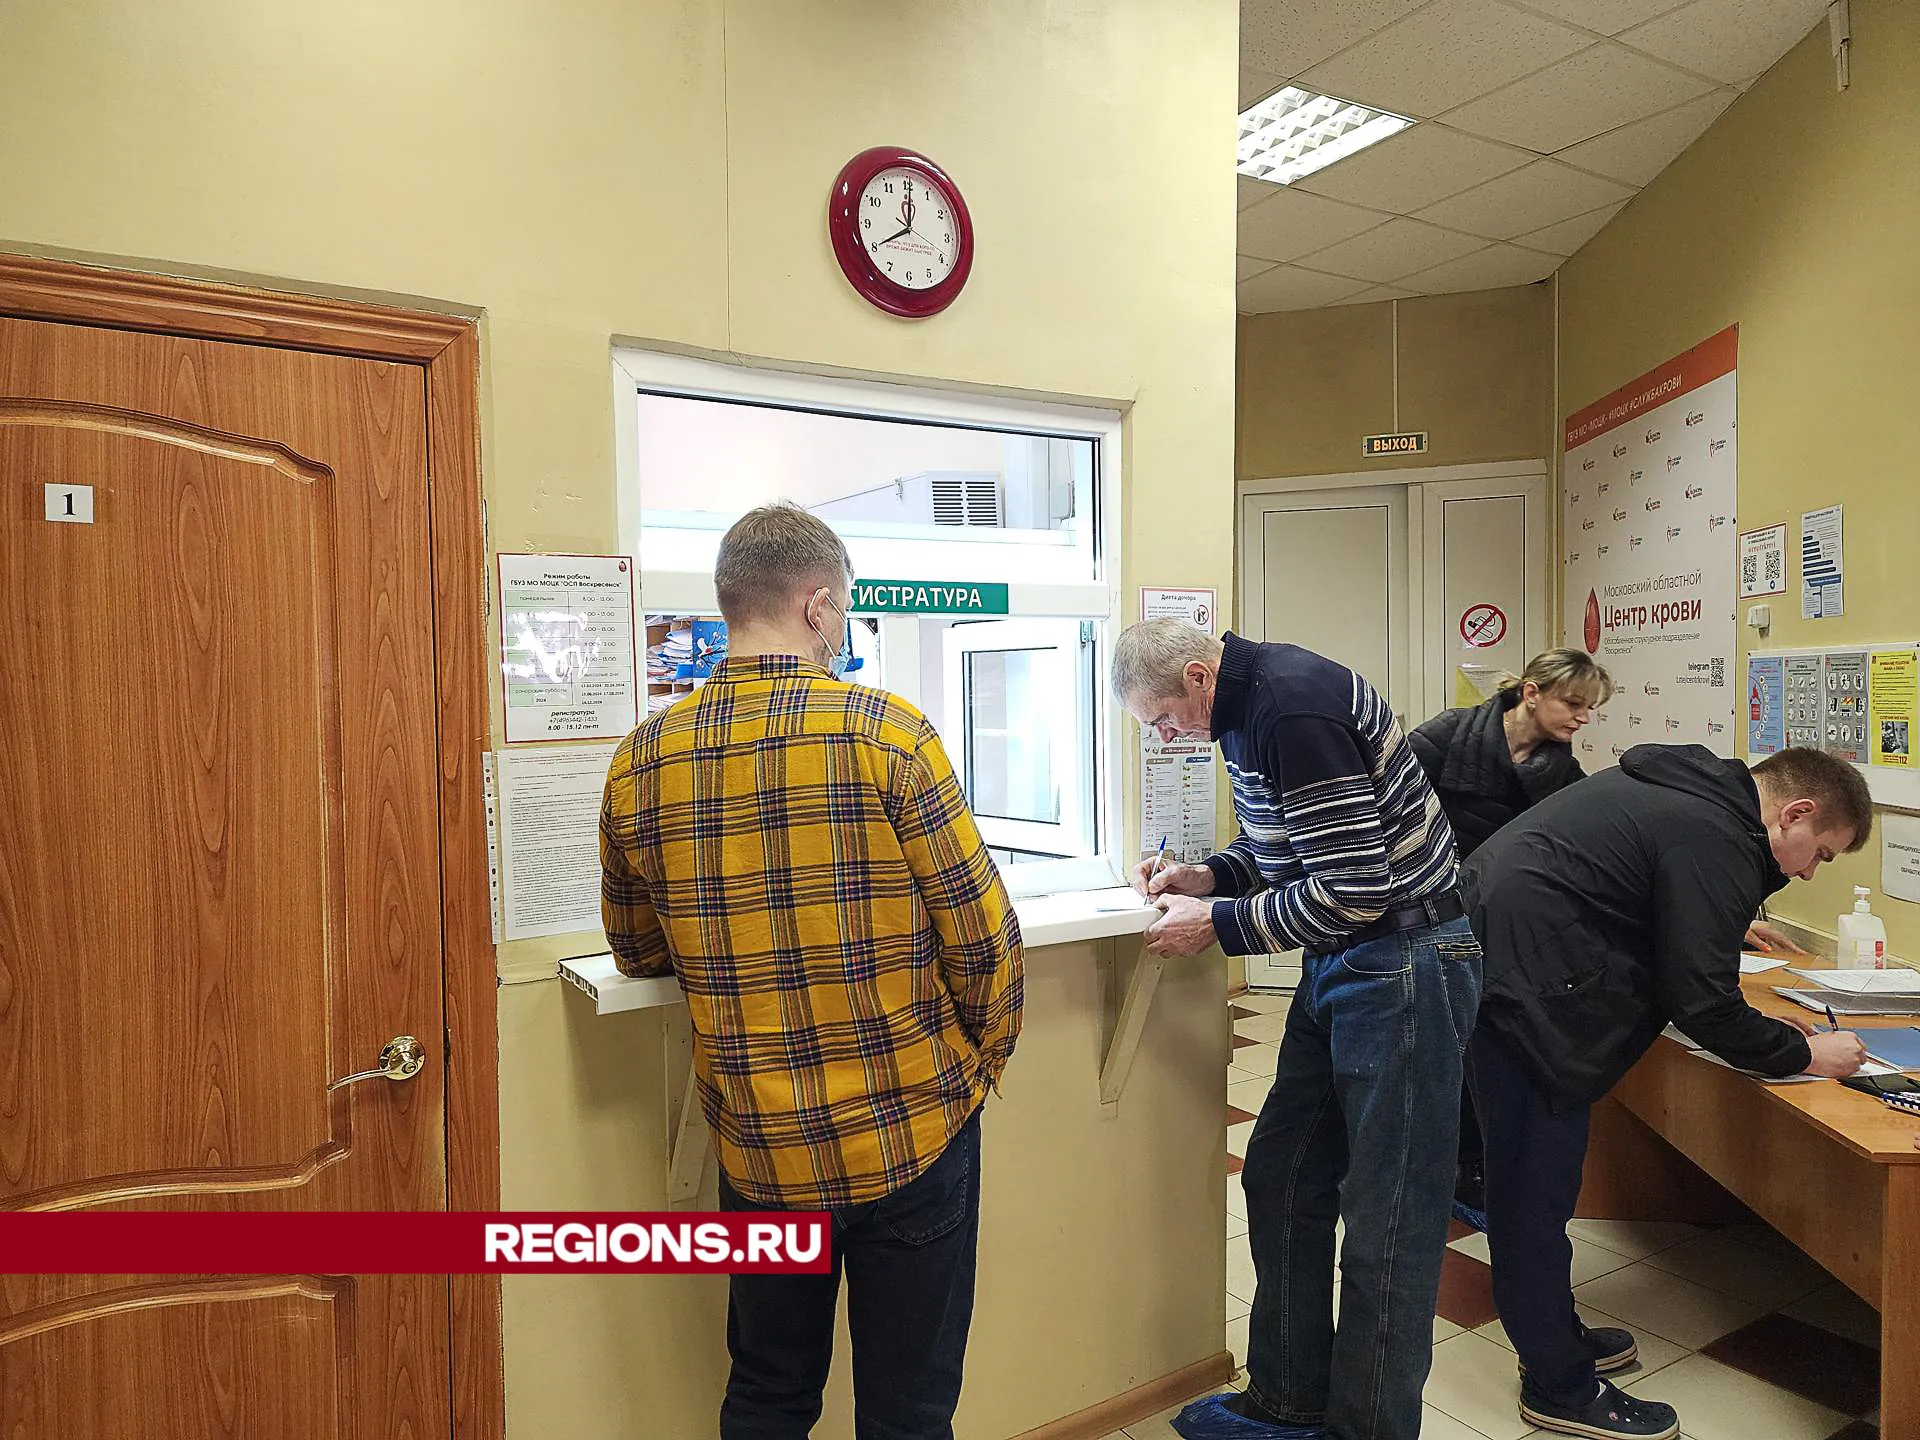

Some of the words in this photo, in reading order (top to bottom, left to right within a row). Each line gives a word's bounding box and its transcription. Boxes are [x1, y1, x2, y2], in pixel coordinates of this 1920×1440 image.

[884, 183, 894, 194] 11
[903, 180, 913, 191] 12
[925, 190, 930, 200] 1
[869, 196, 881, 208] 10
[937, 209, 944, 220] 2
[864, 218, 871, 229] 9
[944, 233, 950, 244] 3
[871, 242, 878, 252] 8
[938, 254, 944, 264] 4
[887, 261, 893, 272] 7
[906, 271, 913, 282] 6
[926, 268, 932, 279] 5
[1373, 436, 1417, 451] ВЫХОД
[61, 492, 77, 516] 1
[1604, 577, 1652, 598] Московский
[1653, 569, 1702, 591] областной
[1160, 593, 1177, 601] Диета
[1604, 605, 1647, 632] Центр
[1651, 599, 1702, 629] крови
[1688, 662, 1710, 673] telegram
[1899, 755, 1908, 764] 112
